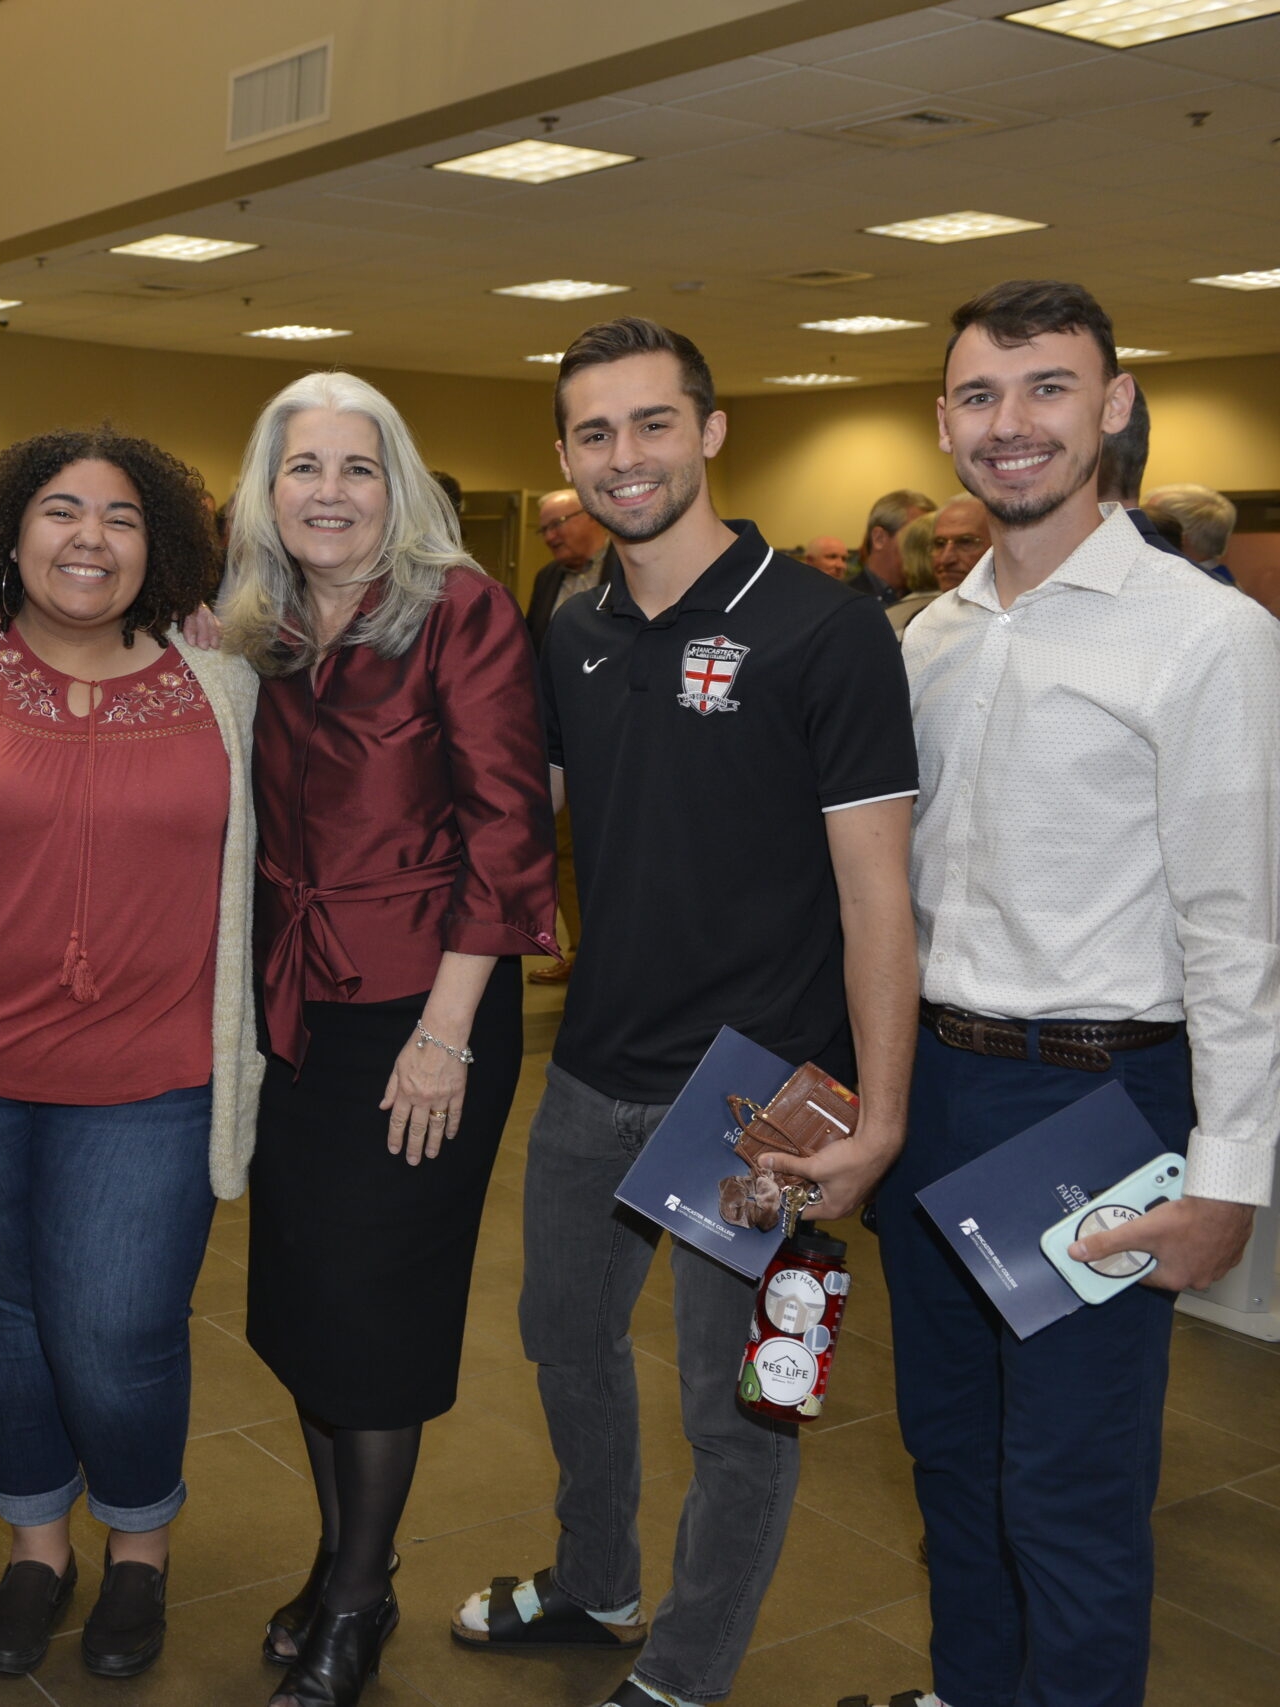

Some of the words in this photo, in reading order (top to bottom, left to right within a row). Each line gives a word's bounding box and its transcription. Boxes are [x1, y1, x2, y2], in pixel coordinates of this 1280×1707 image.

[696, 646, 734, 661] LANCASTER
[1070, 1185, 1089, 1206] GOD
[680, 1203, 704, 1220] LANCASTER
[703, 1217, 716, 1228] BIBLE
[715, 1222, 736, 1238] COLLEGE
[974, 1231, 995, 1257] LANCASTER
[992, 1255, 1004, 1269] BIBLE
[1001, 1267, 1019, 1289] COLLEGE
[775, 1271, 798, 1284] EAST
[800, 1274, 820, 1295] HALL
[762, 1360, 782, 1374] RES
[785, 1367, 809, 1379] LIFE
